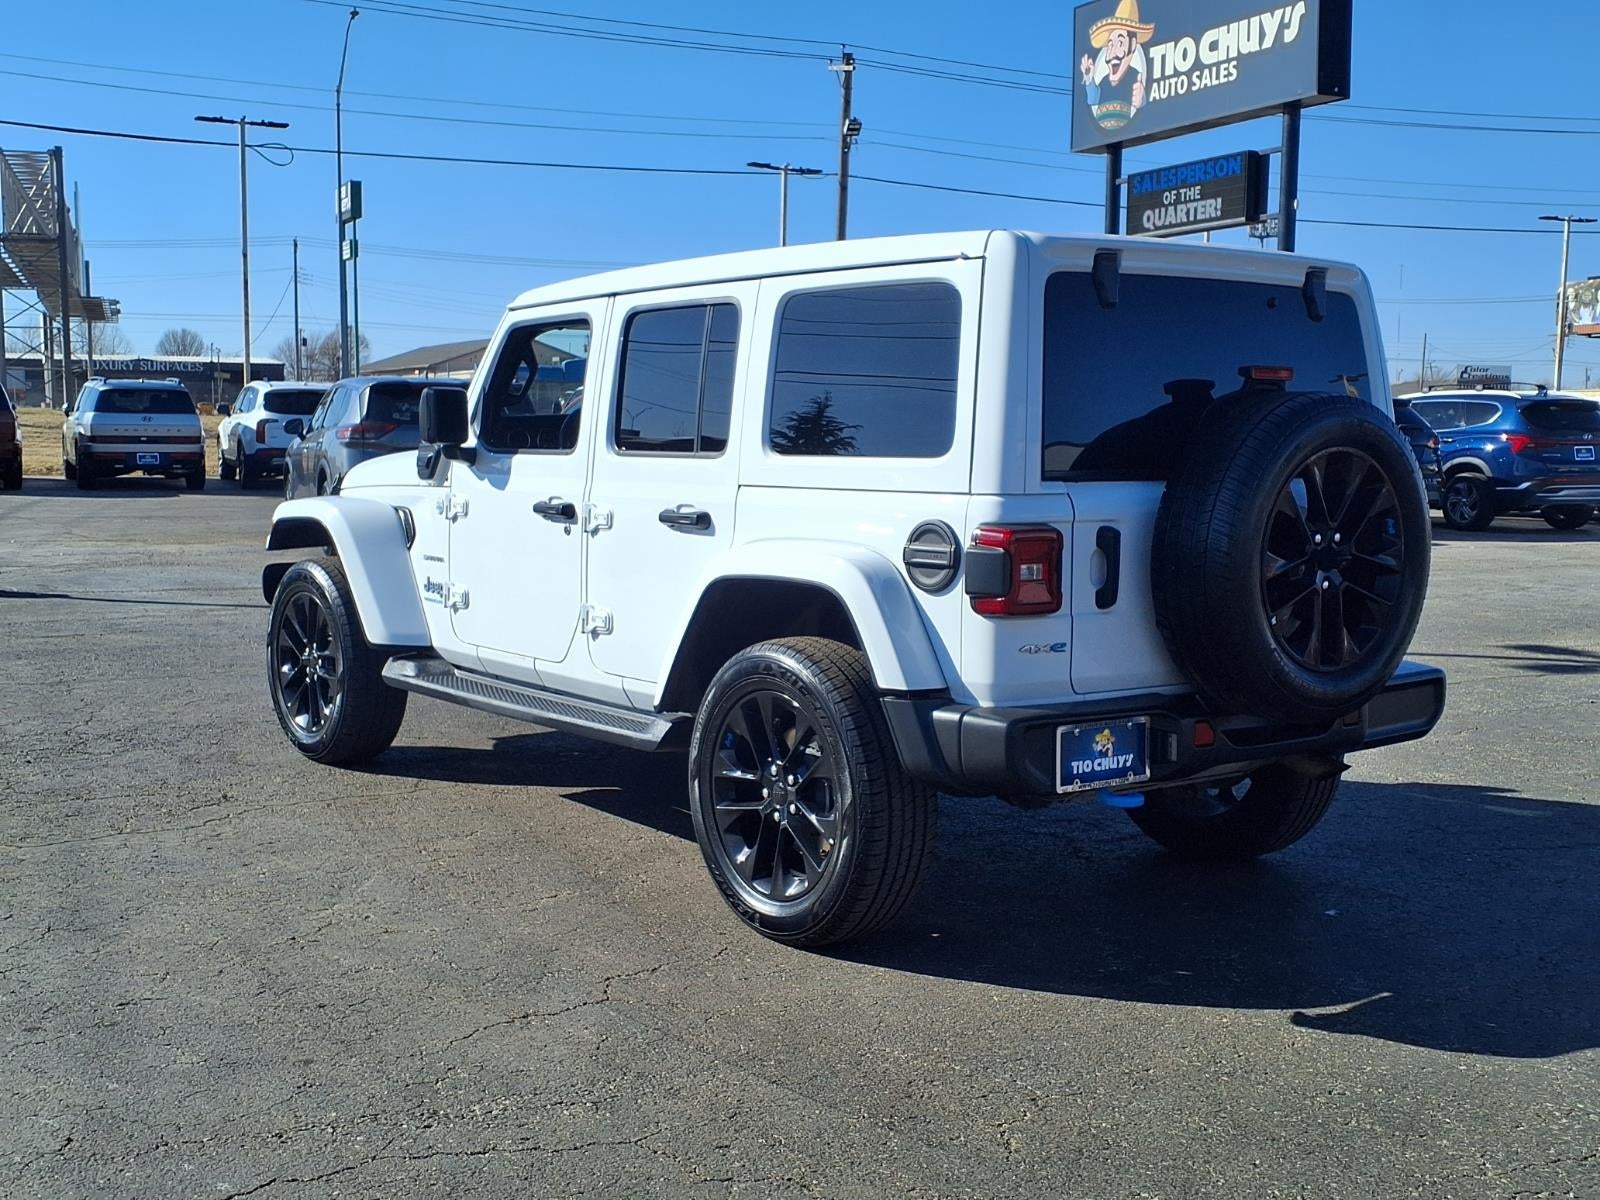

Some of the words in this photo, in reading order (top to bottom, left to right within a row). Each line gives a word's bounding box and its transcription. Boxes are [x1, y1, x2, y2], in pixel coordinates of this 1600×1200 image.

[1149, 36, 1196, 79] TIO
[1199, 2, 1306, 64] CHUY'S
[1149, 76, 1188, 102] AUTO
[1191, 61, 1238, 91] SALES
[1133, 156, 1242, 193] SALESPERSON
[1163, 189, 1177, 204] OF
[1180, 186, 1201, 202] THE
[1142, 197, 1222, 229] QUARTER!
[140, 361, 204, 372] SURFACES
[1071, 760, 1093, 775] TIO
[1093, 753, 1134, 772] CHUY'S
